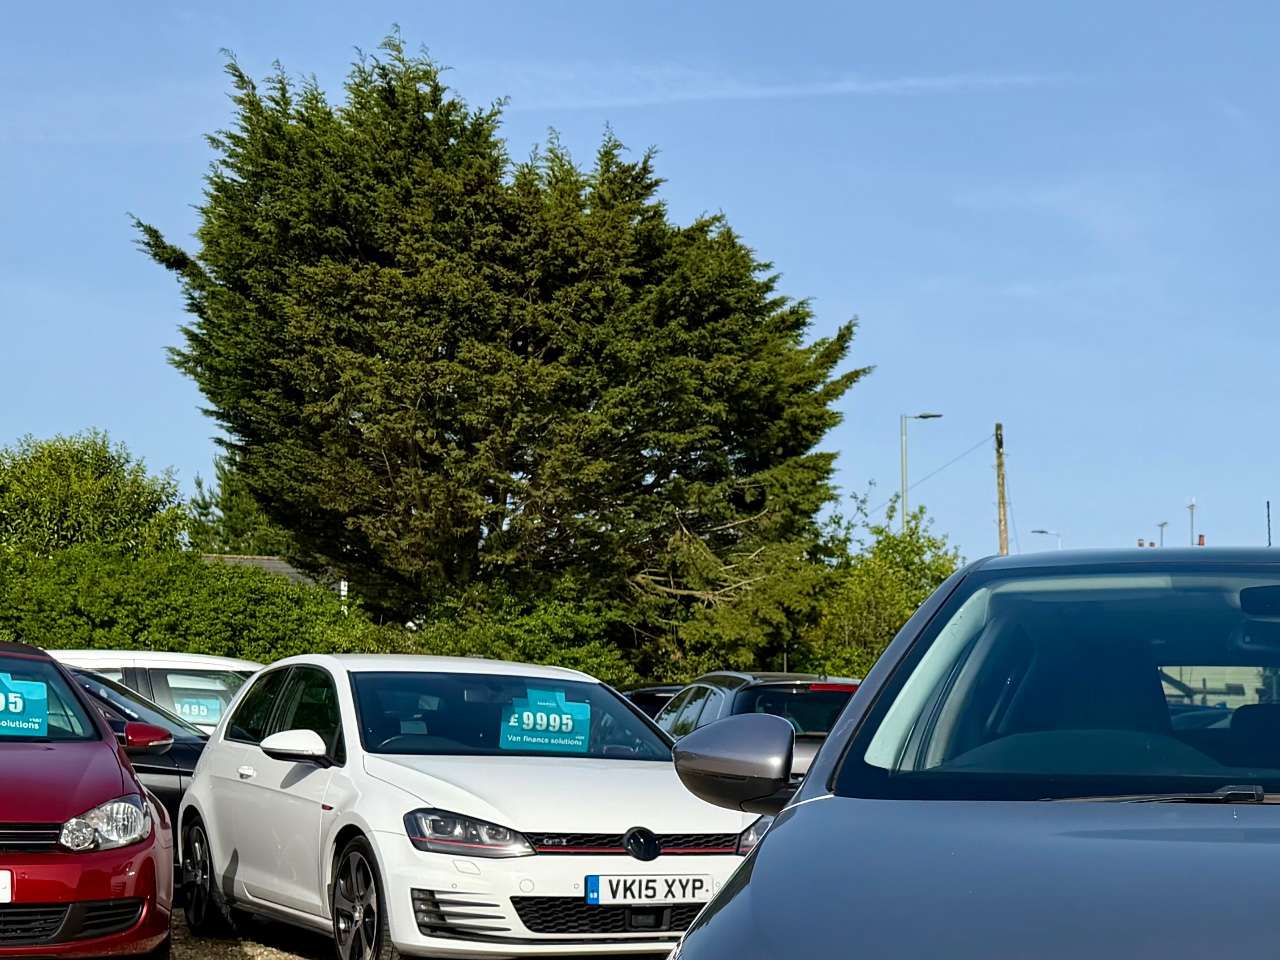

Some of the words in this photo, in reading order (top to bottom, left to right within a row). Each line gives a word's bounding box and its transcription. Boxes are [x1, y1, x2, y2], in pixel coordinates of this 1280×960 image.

[0, 719, 40, 730] olutions
[508, 711, 573, 733] £9995
[507, 734, 521, 742] Van
[523, 735, 549, 744] finance
[550, 738, 583, 746] solutions
[608, 878, 657, 900] VK15
[663, 878, 705, 900] XYP
